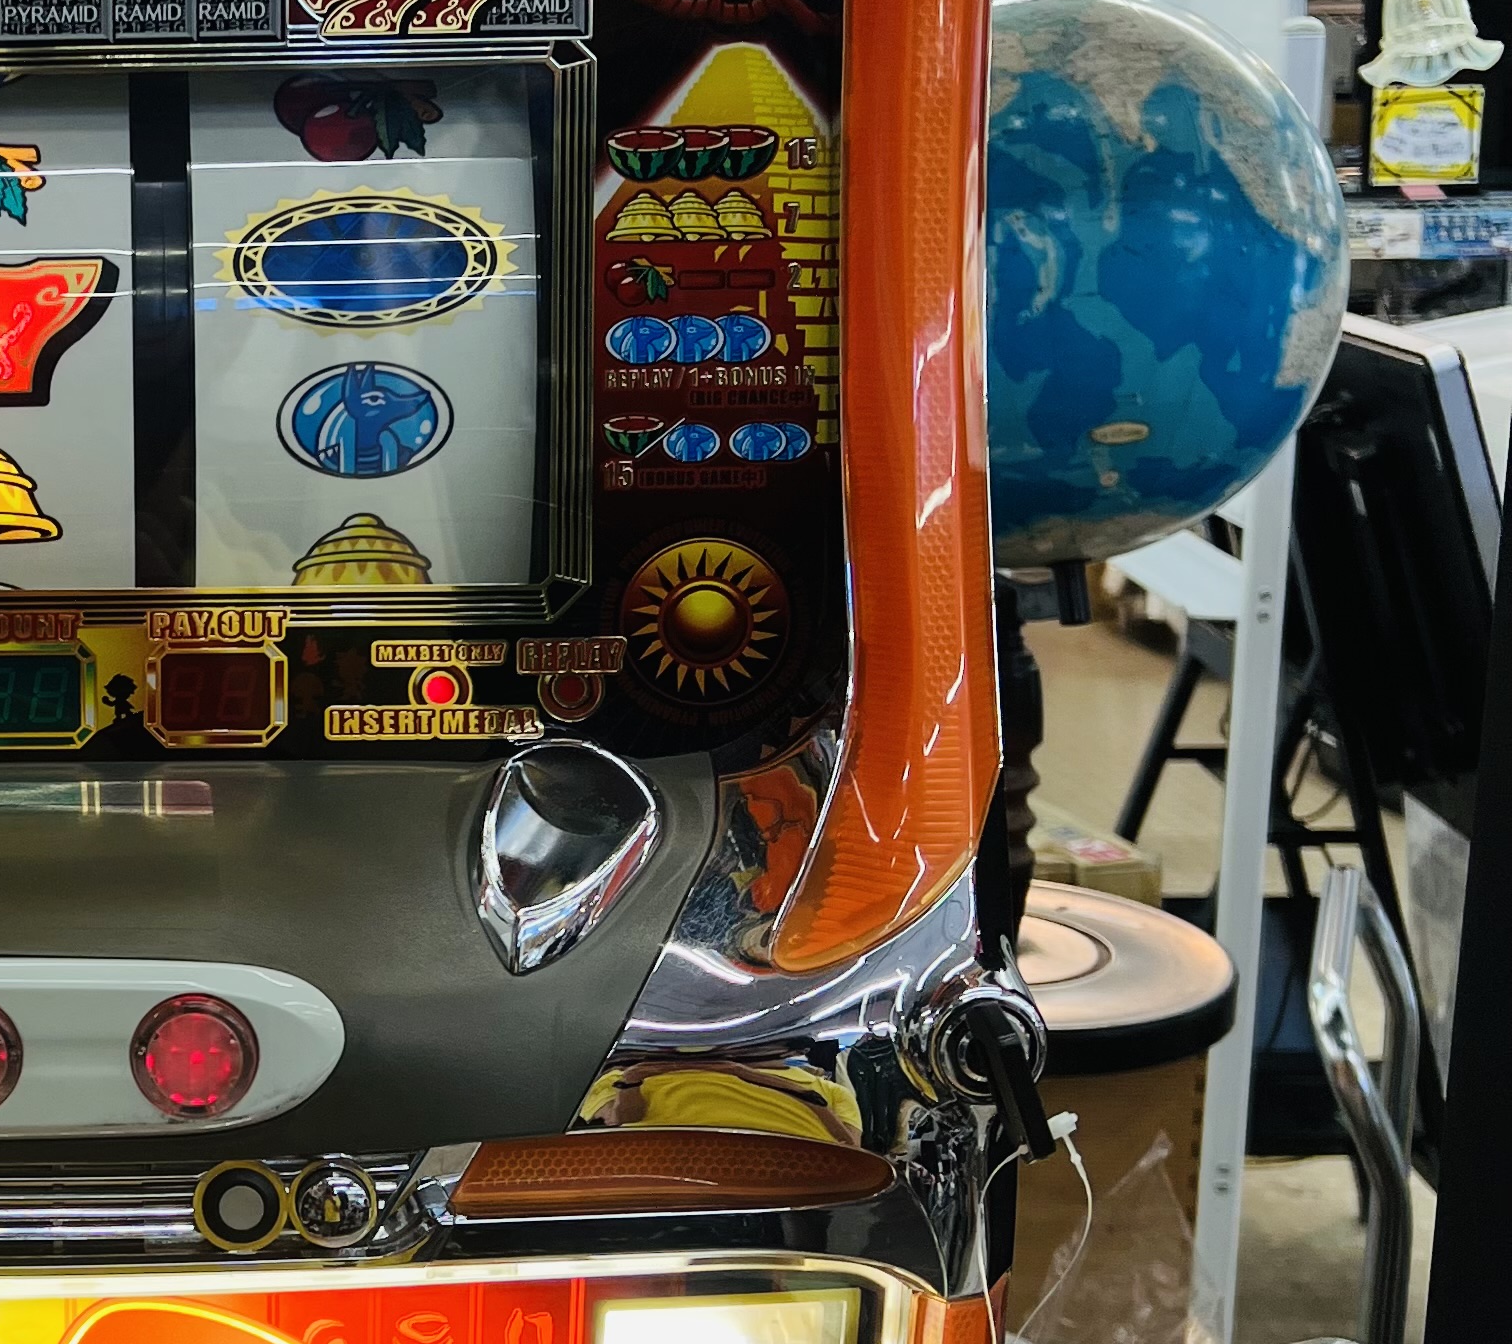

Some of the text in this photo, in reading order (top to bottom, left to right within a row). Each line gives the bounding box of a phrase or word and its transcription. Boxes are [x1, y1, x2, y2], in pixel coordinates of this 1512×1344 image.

[3, 2, 98, 25] PYRAMID
[153, 612, 286, 639] PAY OUT
[377, 643, 505, 662] MAXBET ONLY
[522, 641, 623, 672] REPLAY
[332, 709, 539, 735] INSERT MEDAL
